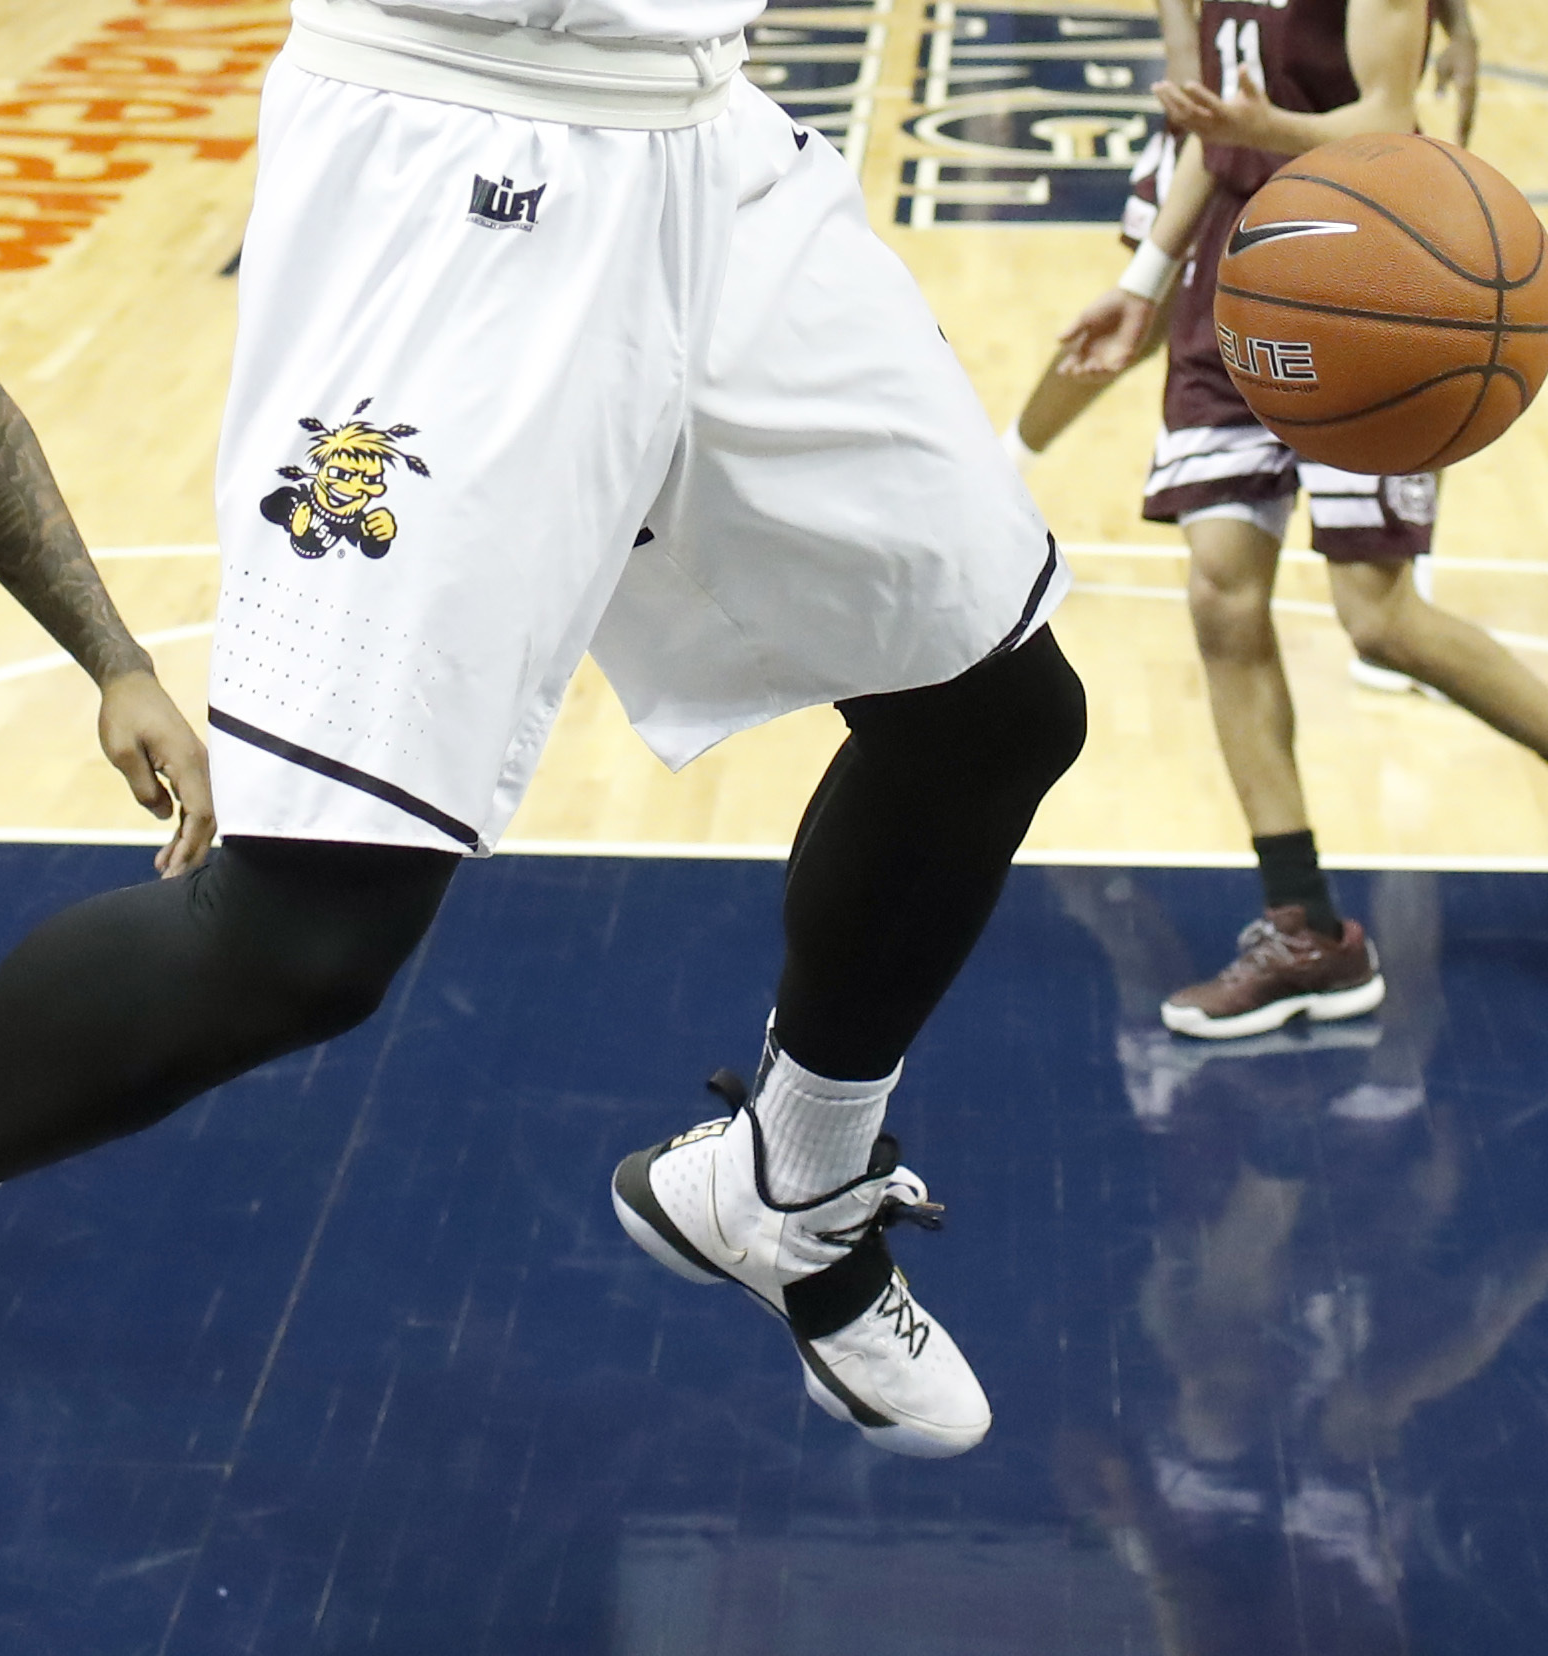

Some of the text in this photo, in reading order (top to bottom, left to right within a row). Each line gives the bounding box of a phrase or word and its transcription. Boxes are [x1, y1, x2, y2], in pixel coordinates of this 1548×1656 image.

[1214, 17, 1268, 102] 11
[1216, 322, 1318, 382] ELITE
[309, 514, 338, 550] WSU
